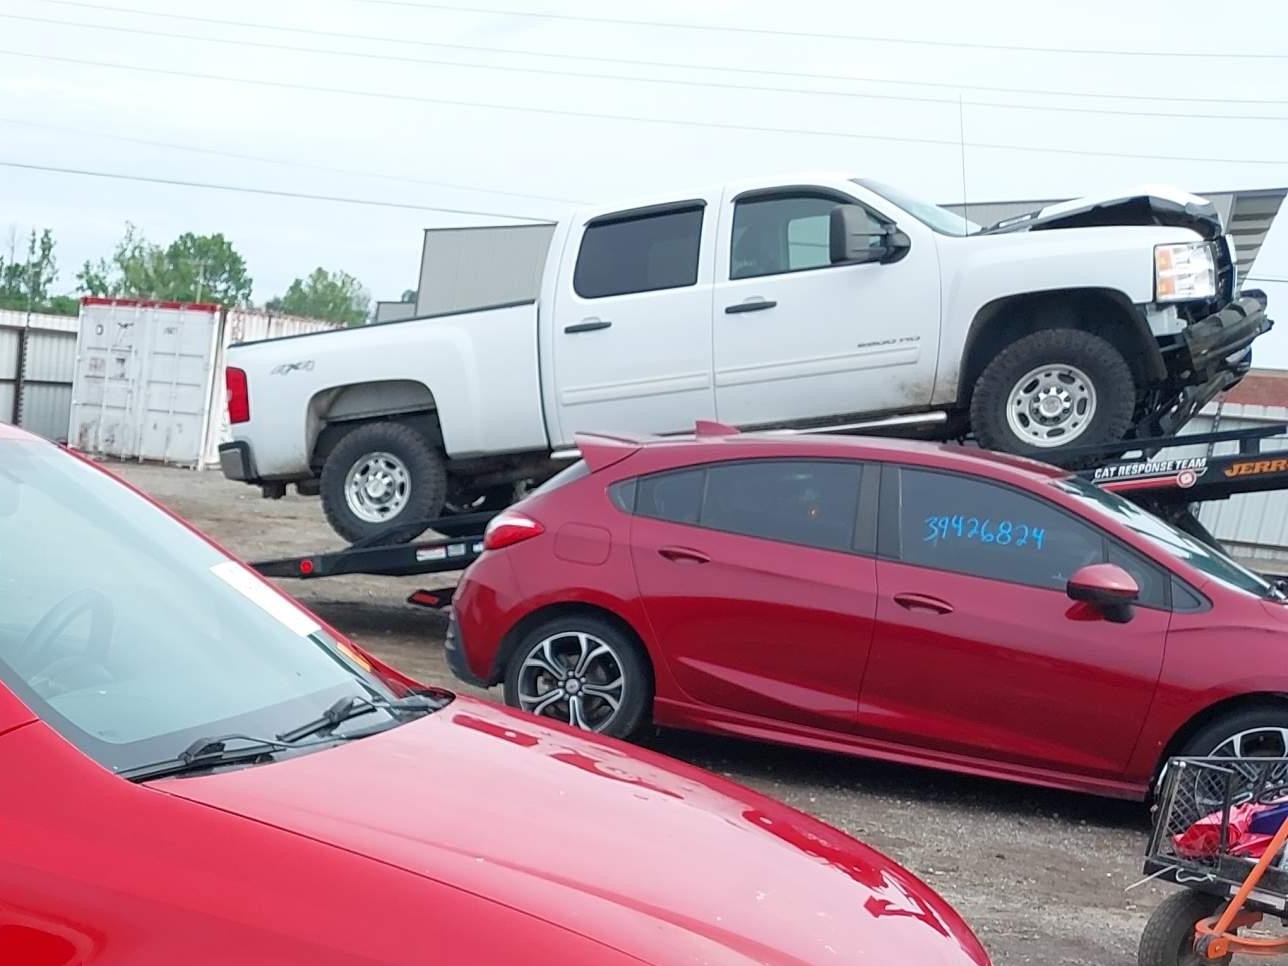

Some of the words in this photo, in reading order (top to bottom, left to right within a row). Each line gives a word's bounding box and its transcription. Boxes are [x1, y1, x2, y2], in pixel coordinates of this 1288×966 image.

[1094, 466, 1117, 479] CAT
[1117, 461, 1174, 477] RESPONSE
[1174, 457, 1207, 470] TEAM
[923, 513, 1046, 550] 39426824
